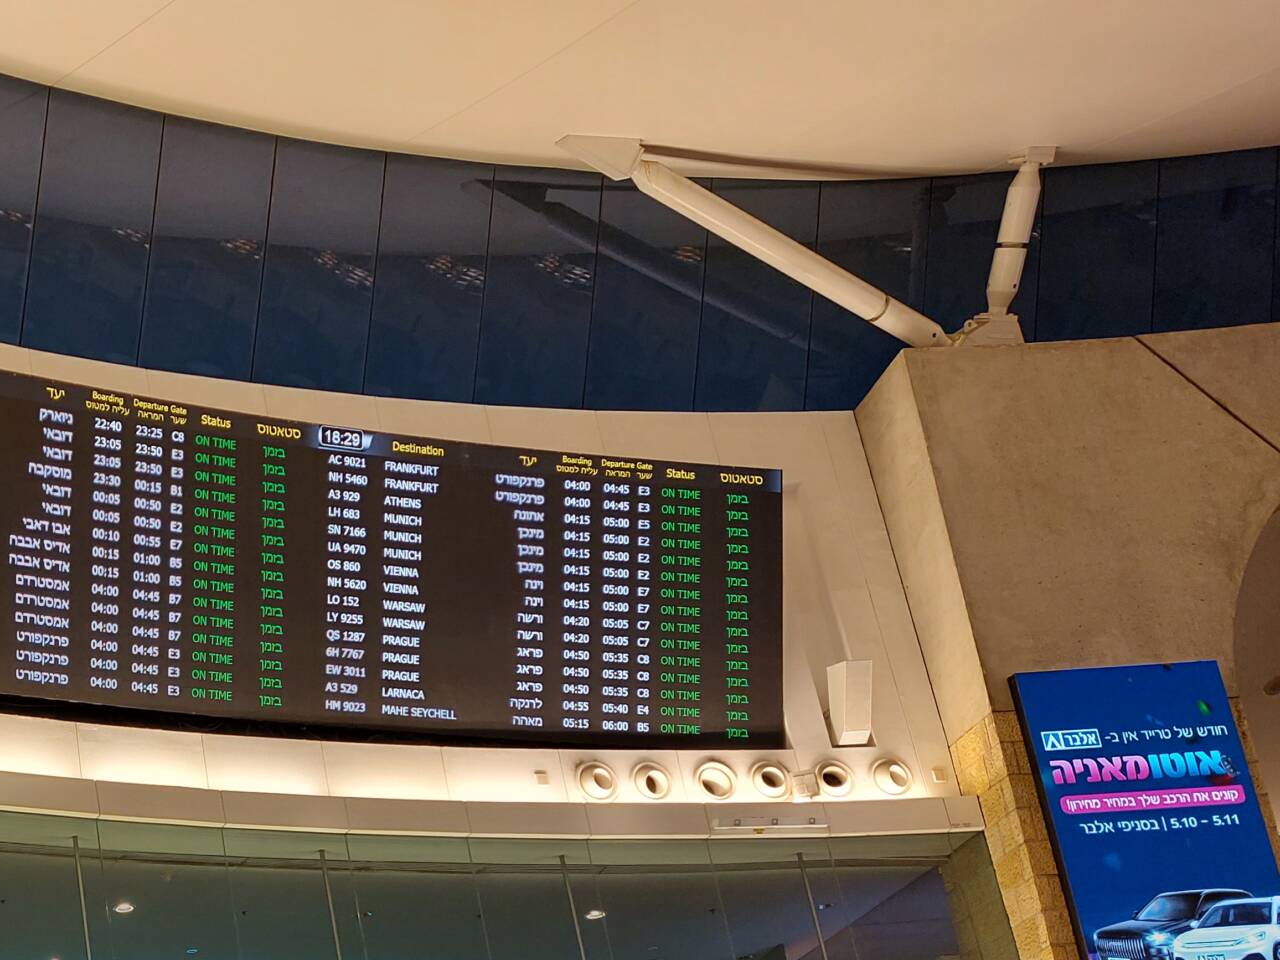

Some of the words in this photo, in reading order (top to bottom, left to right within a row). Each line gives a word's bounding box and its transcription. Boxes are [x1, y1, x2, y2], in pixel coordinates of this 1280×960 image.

[92, 391, 124, 406] Boarding
[134, 398, 168, 413] Departure
[170, 406, 187, 416] Gate
[201, 414, 232, 429] Status
[196, 435, 214, 448] ON
[214, 438, 236, 450] TIME
[324, 428, 360, 448] 18:29
[392, 441, 444, 457] Destination
[562, 455, 592, 466] Boarding
[602, 458, 635, 470] Departure
[636, 462, 653, 472] Gate
[384, 460, 439, 477] FRANKFURT
[666, 468, 696, 480] Status
[384, 495, 422, 509] ATHENS
[384, 512, 422, 526] MUNICH
[384, 565, 419, 578] VIENNA
[383, 600, 426, 613] WARSAW
[382, 634, 420, 648] PRAGUE
[382, 687, 425, 700] LARNACA
[382, 704, 408, 718] MAHE
[410, 706, 456, 720] SEYCHELL
[1140, 728, 1171, 741] טרייד
[1174, 726, 1193, 739] של
[1196, 724, 1228, 736] חודש
[1064, 733, 1097, 745] אלבר
[1122, 731, 1138, 744] אין
[1049, 750, 1226, 785] אוטומאניה
[1106, 797, 1136, 807] במחיר
[1142, 795, 1160, 807] שלך
[1164, 793, 1191, 804] הרכב
[1193, 792, 1210, 802] את
[1212, 790, 1239, 801] קונים
[1118, 819, 1160, 831] בסניפי
[1170, 816, 1197, 828] 5.10
[1212, 814, 1240, 826] 5.11
[1080, 822, 1115, 834] אלבר
